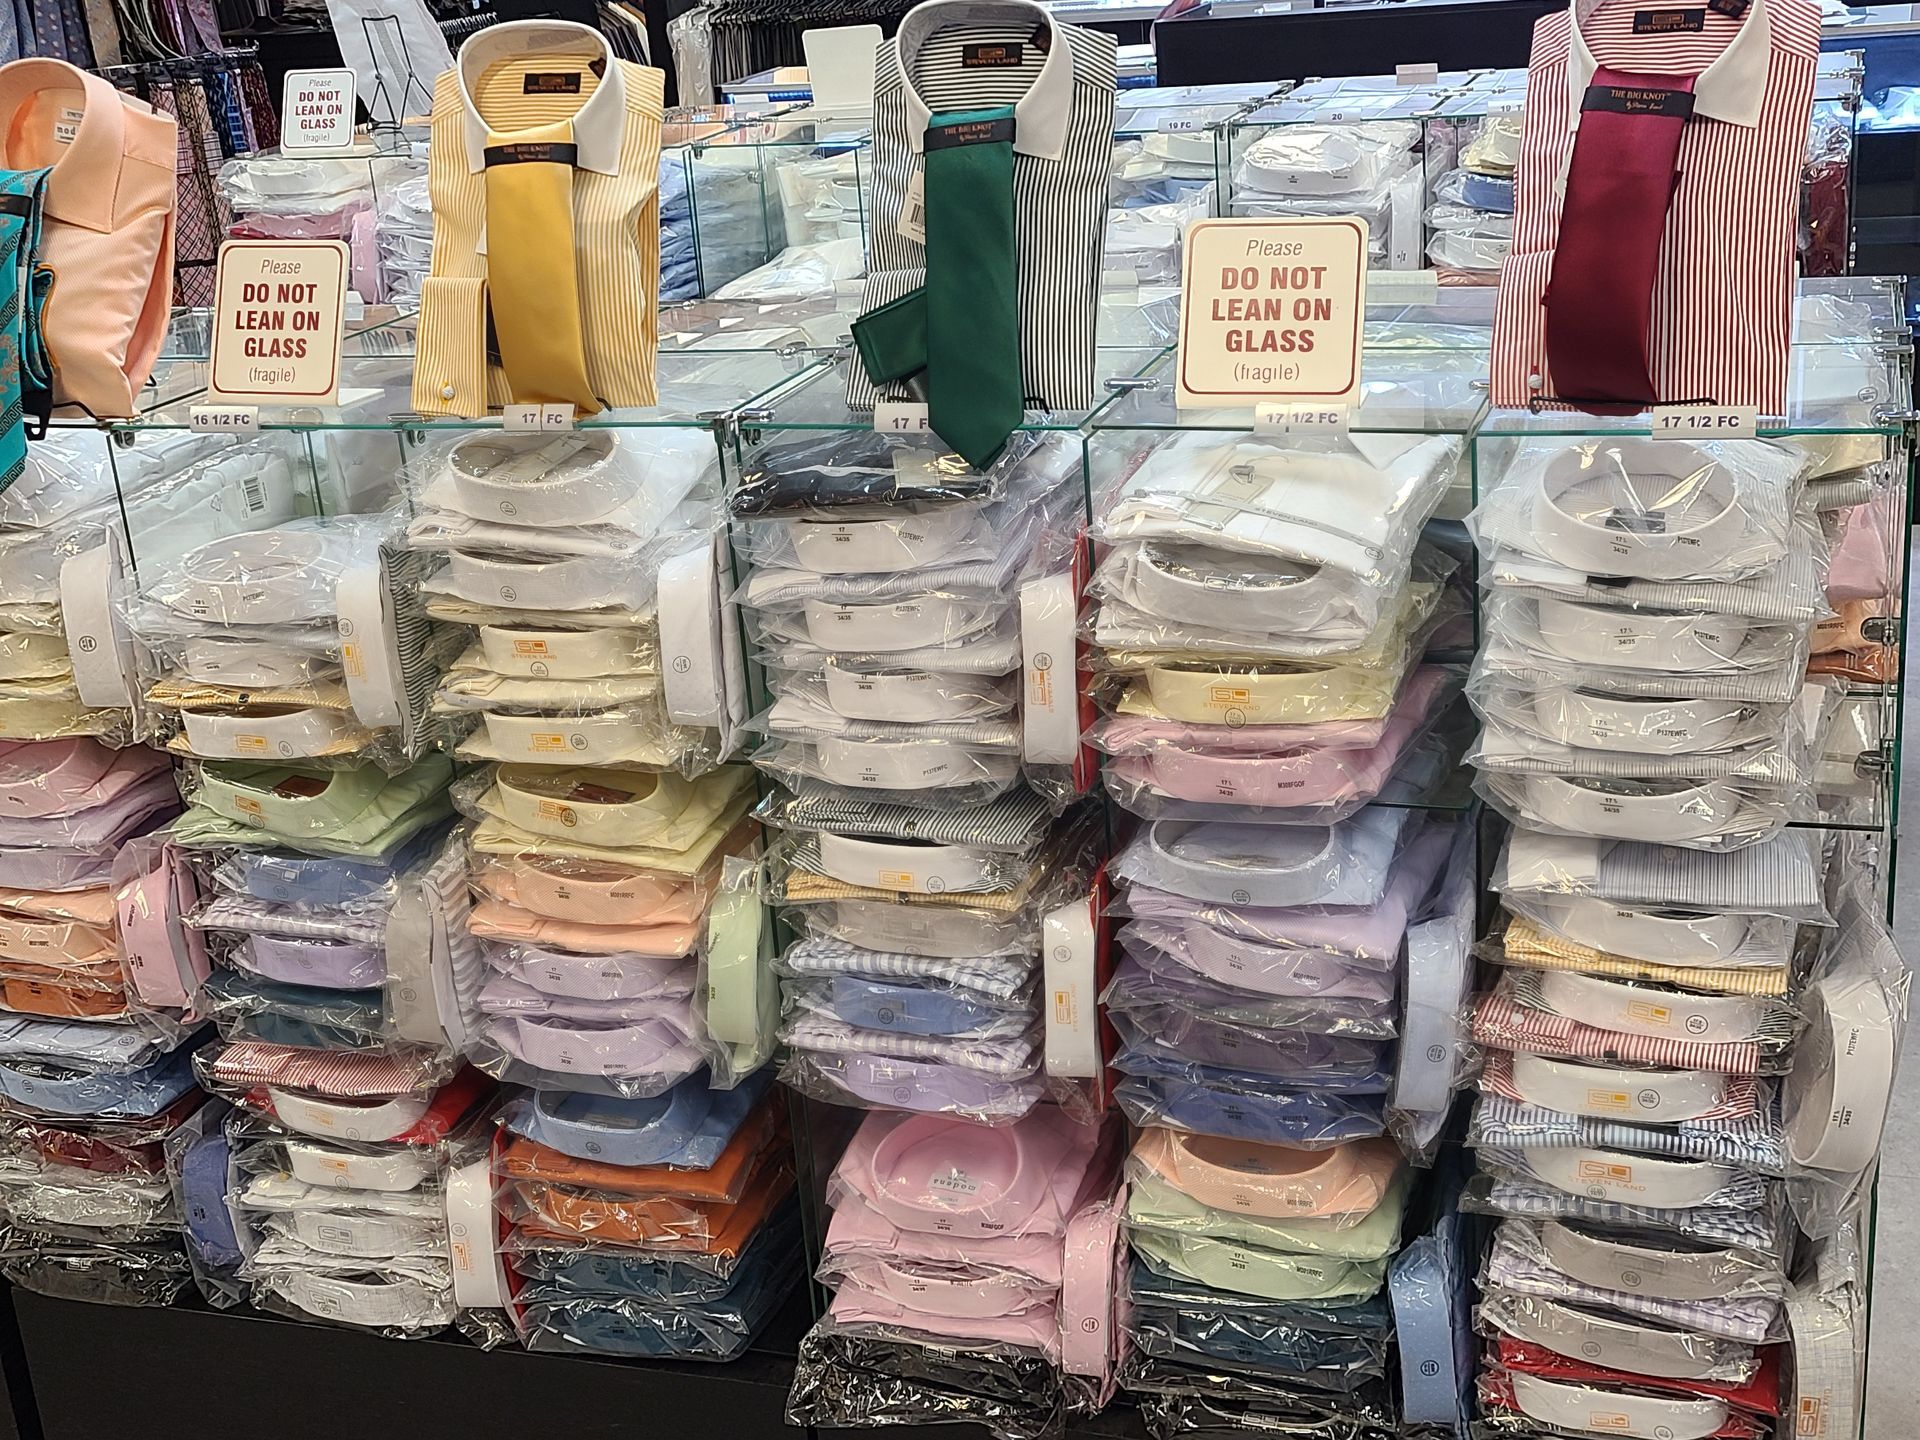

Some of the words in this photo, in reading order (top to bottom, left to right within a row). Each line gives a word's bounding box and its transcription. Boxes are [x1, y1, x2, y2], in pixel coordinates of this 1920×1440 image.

[1673, 22, 1698, 30] LAND
[308, 79, 332, 87] Please
[299, 92, 314, 102] DO
[318, 90, 341, 101] NOT
[1611, 90, 1626, 98] THE
[1627, 90, 1642, 99] BIG
[296, 105, 322, 116] LEAN
[327, 104, 342, 114] ON
[300, 118, 336, 130] GLASS
[1246, 239, 1303, 256] Please
[260, 259, 301, 274] Please
[1221, 266, 1260, 290] DO
[1270, 266, 1328, 290] NOT
[242, 283, 270, 304] DO
[277, 284, 318, 304] NOT
[1212, 298, 1282, 322] LEAN
[1293, 298, 1332, 321] ON
[235, 310, 284, 330] LEAN
[292, 310, 320, 331] ON
[1226, 329, 1315, 353] GLASS
[244, 338, 307, 358] GLASS
[249, 367, 296, 384] (fragile)
[1234, 362, 1300, 384] (fragile)
[194, 414, 208, 425] 16
[212, 414, 230, 425] 1/2
[234, 414, 250, 425] FC
[522, 413, 536, 424] 17
[546, 414, 563, 424] FC
[892, 418, 910, 429] 17
[1266, 413, 1285, 424] 17
[1292, 412, 1314, 424] 1/2
[1318, 412, 1338, 424] FC
[1662, 416, 1682, 428] 17
[1688, 416, 1712, 428] 1/2
[1718, 416, 1740, 428] FC
[1613, 546, 1628, 555] 34/35
[1616, 910, 1634, 919] 34/35
